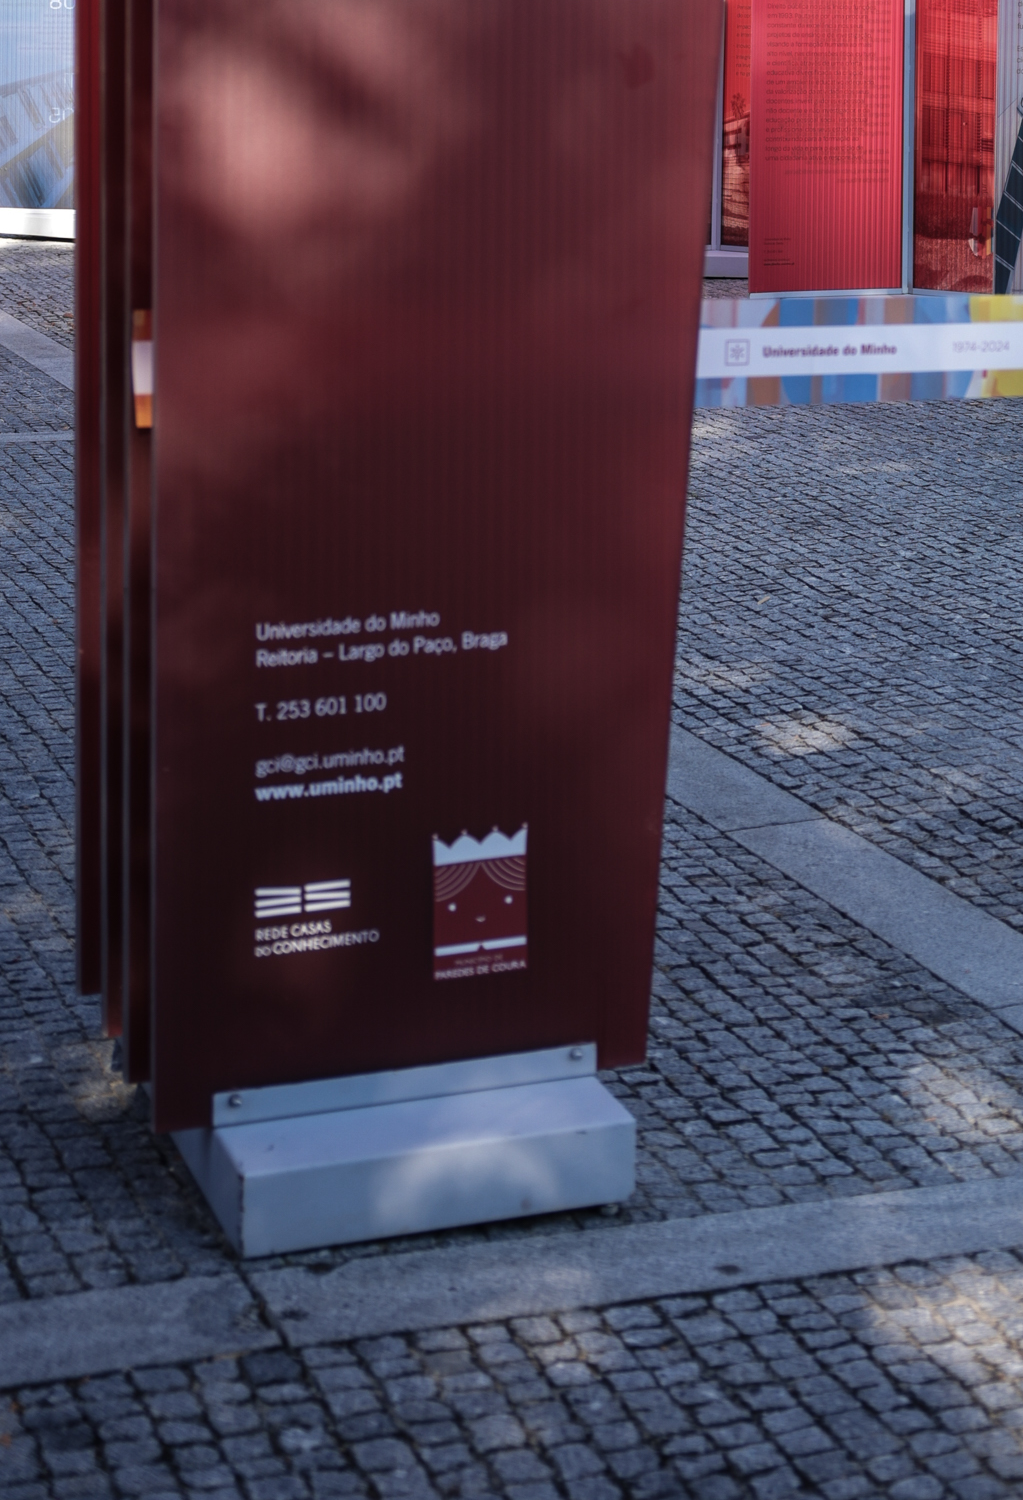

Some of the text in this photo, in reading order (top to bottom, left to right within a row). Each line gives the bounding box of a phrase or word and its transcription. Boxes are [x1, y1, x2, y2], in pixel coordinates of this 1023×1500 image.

[762, 344, 897, 358] Universidade do Minho
[953, 340, 1010, 353] 1974-2024
[256, 611, 440, 641] Universidade do Minho
[256, 649, 318, 667] Reitoria
[339, 644, 385, 662] Largo
[388, 639, 409, 656] do
[413, 636, 457, 655] Paço,
[462, 632, 508, 650] Braga
[255, 692, 387, 721] T. 253 601 100
[255, 746, 404, 778] gci@gci.uminho.pt
[255, 772, 402, 801] www.uminho.pt
[256, 921, 332, 940] REDE CASAS
[271, 931, 378, 954] CONHECIMENTO
